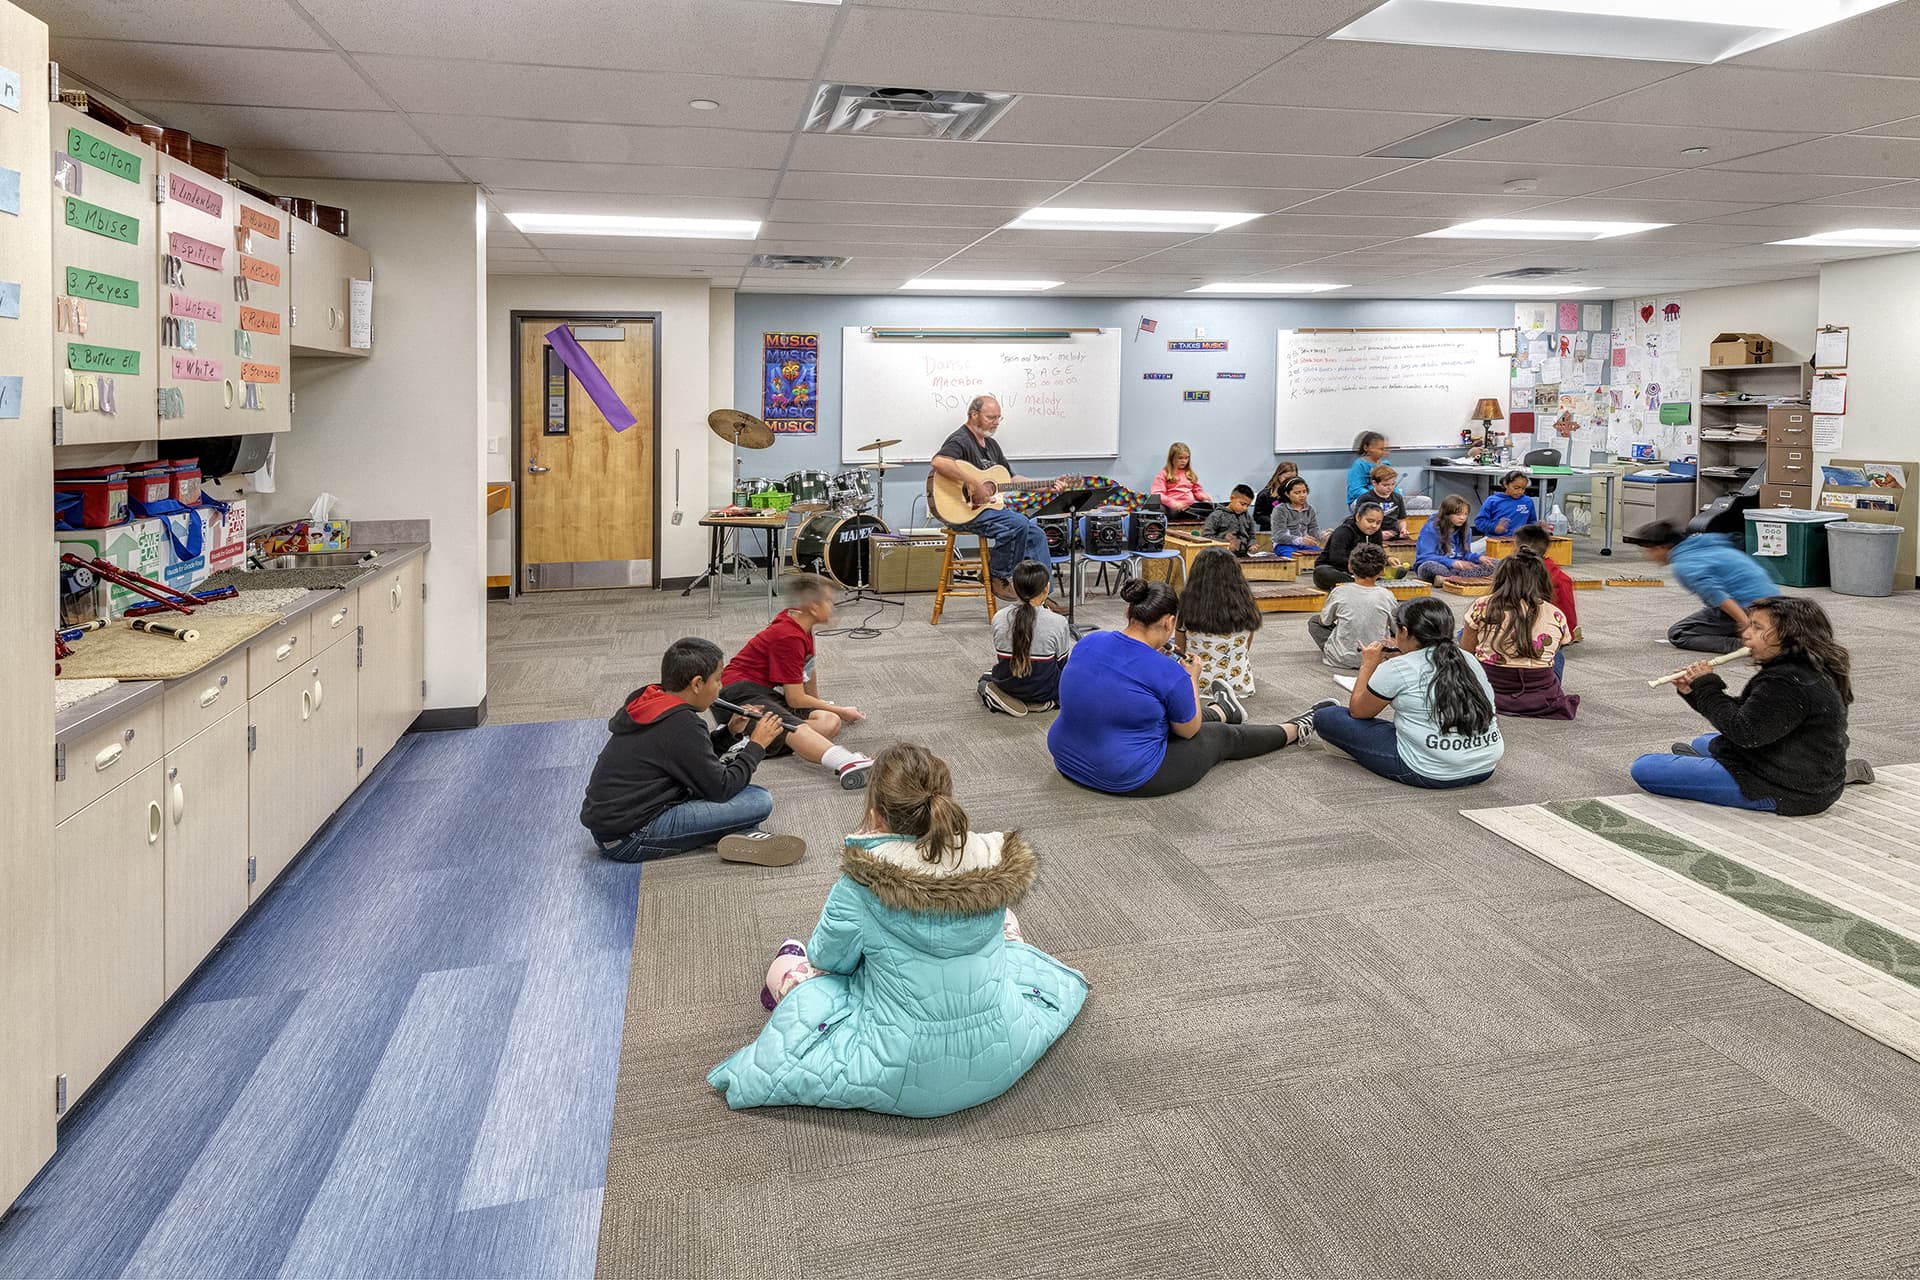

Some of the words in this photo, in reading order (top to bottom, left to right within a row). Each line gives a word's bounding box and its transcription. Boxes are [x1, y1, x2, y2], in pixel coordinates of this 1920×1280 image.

[90, 142, 132, 174] Colton
[85, 275, 129, 300] Reyes
[766, 335, 817, 348] MUSIC
[766, 349, 817, 361] MUSIC
[186, 360, 215, 377] White
[766, 406, 815, 418] MUSIC
[764, 421, 815, 433] MUSIC
[138, 532, 160, 547] GAME
[839, 526, 875, 544] MAPEX
[141, 546, 159, 561] PLAN
